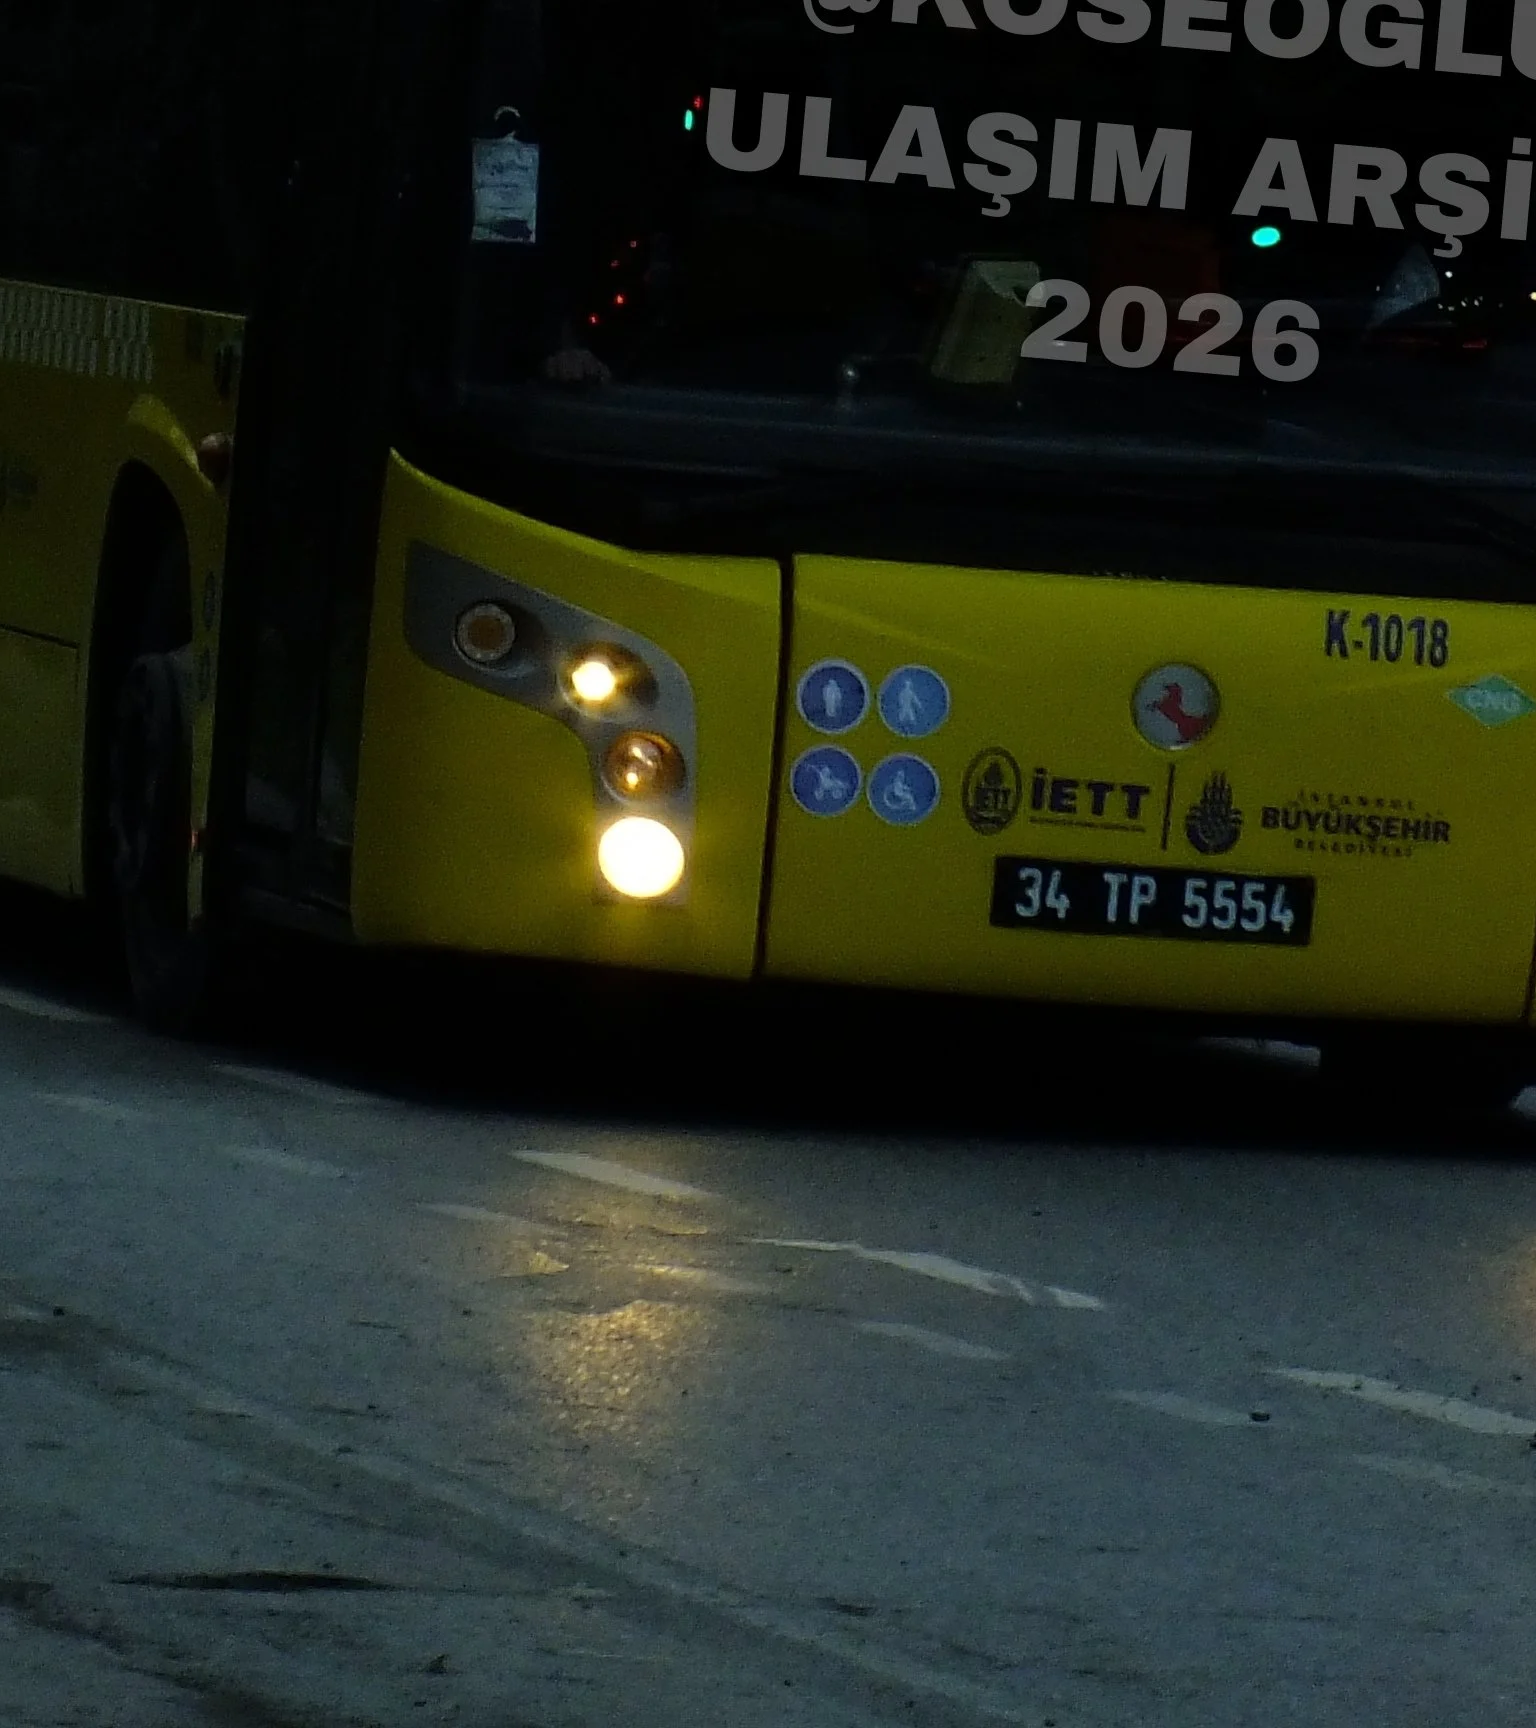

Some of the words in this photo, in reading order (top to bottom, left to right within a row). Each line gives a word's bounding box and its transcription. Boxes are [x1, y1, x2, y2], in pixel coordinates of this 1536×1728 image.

[1326, 609, 1447, 667] K-1018
[1030, 768, 1150, 819] İETT
[1014, 866, 1071, 921] 34
[1103, 871, 1158, 926] TP
[1181, 877, 1296, 934] 5554
